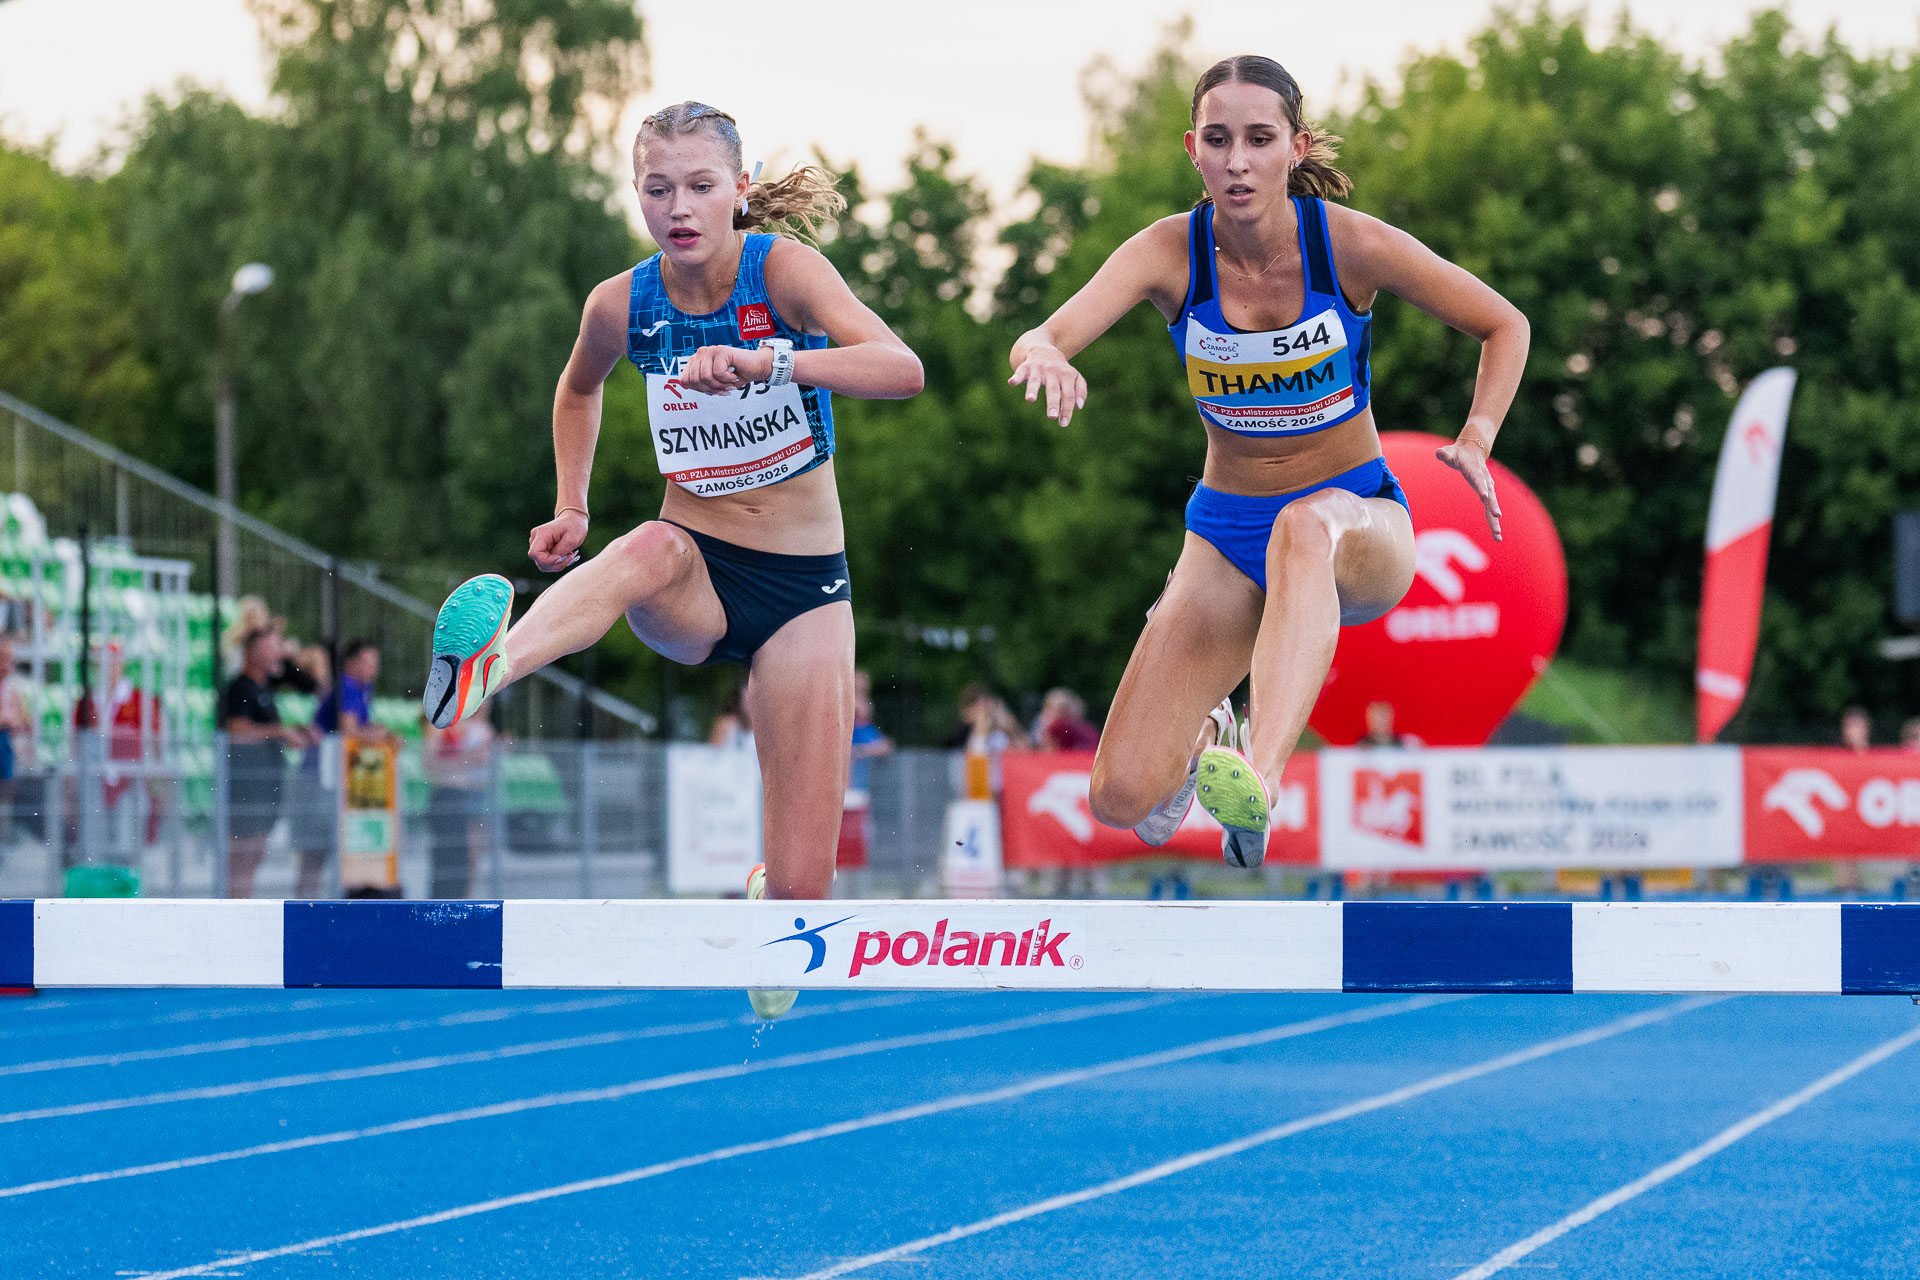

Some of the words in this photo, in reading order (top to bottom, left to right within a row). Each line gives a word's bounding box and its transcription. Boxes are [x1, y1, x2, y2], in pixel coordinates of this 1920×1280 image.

[1272, 322, 1331, 356] 544
[1198, 361, 1335, 396] THAMM
[663, 402, 698, 411] ORLEN
[1206, 404, 1219, 412] 80.
[1221, 408, 1241, 416] PZLA
[1242, 408, 1296, 416] Mistrzostwa
[1298, 402, 1323, 414] Polski
[1324, 394, 1341, 406] U20
[1226, 418, 1287, 428] ZAMOŚĆ
[1291, 413, 1325, 427] 2026
[659, 405, 800, 455] SZYMAŃSKA
[675, 474, 689, 482] 80.
[690, 470, 710, 479] PZLA
[711, 462, 760, 476] Mistrzostwa
[762, 453, 785, 467] Polski
[786, 444, 802, 456] U20
[696, 477, 755, 494] ZAMOŚĆ
[757, 464, 789, 483] 2026
[848, 918, 1071, 979] polanik
